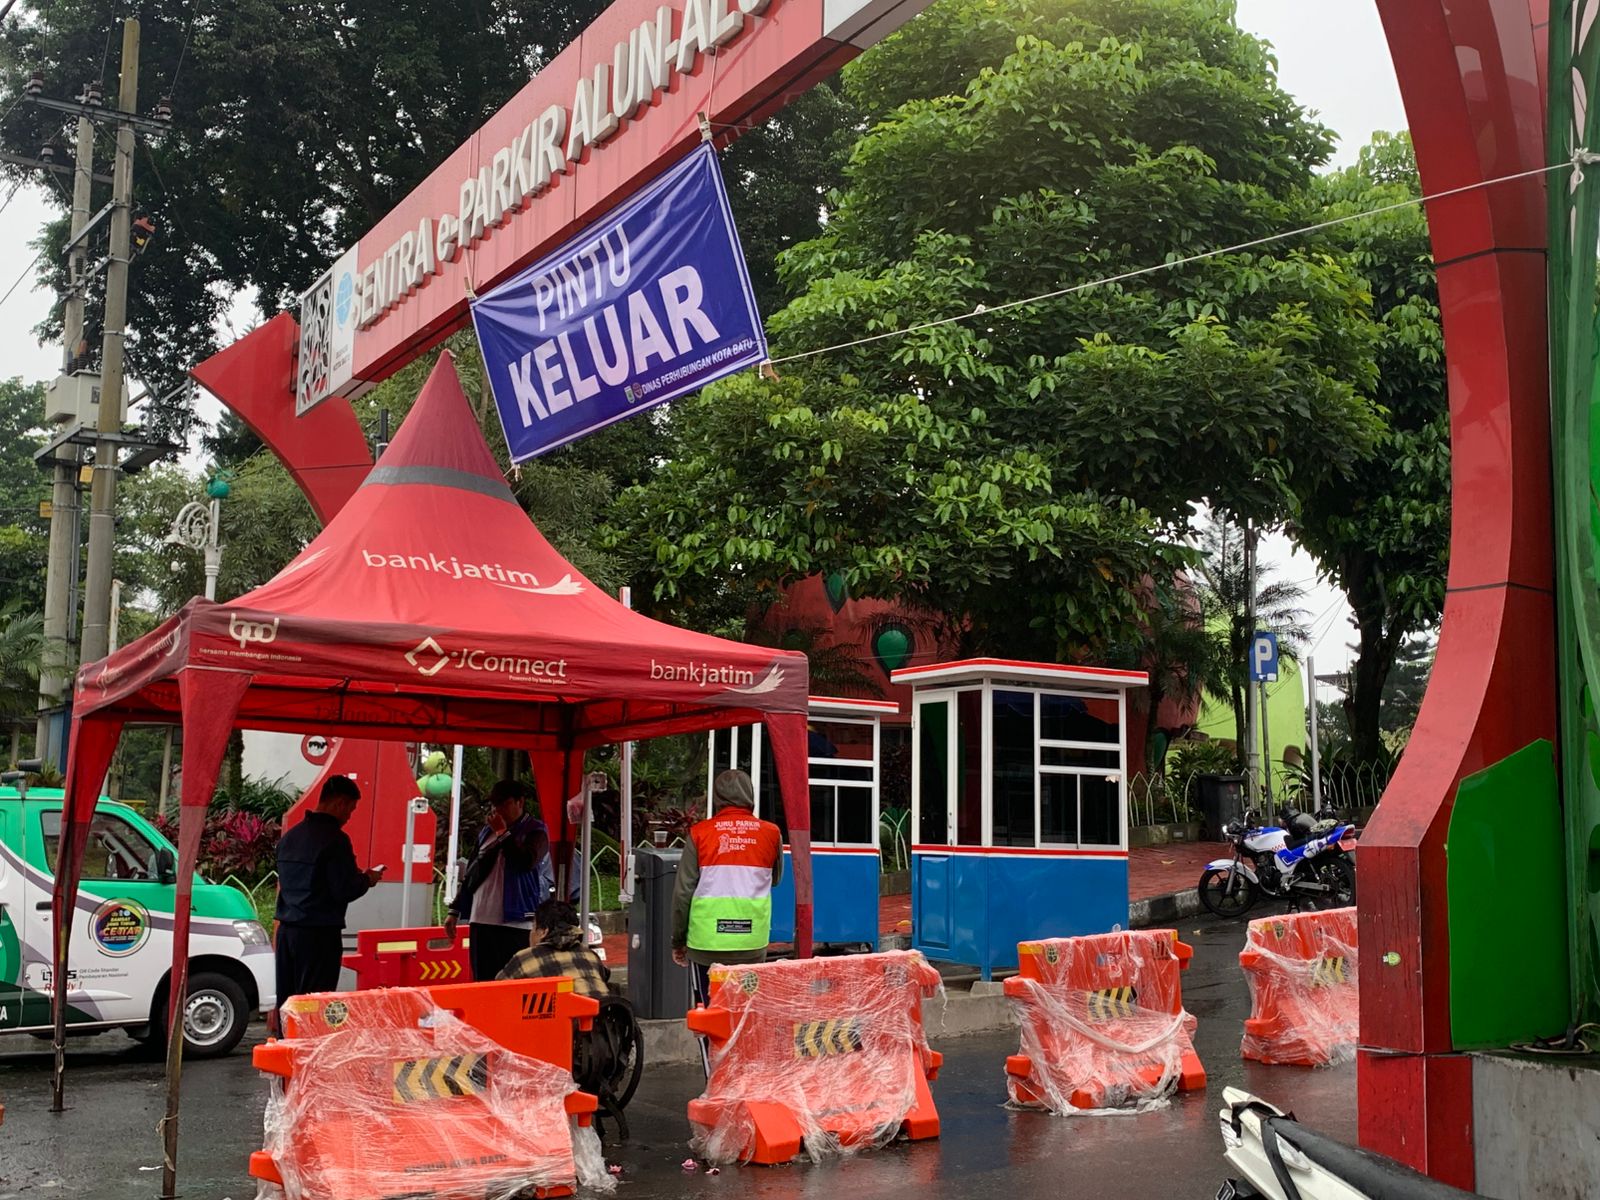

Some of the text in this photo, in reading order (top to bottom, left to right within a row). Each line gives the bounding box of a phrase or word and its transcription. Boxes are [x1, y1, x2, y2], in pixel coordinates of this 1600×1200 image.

[351, 217, 435, 331] SENTRA
[437, 104, 567, 262] e-PARKIR
[531, 223, 631, 332] PINTU
[508, 265, 721, 428] KELUAR
[641, 338, 753, 395] DINAS PERHUBUNGAN KOTA BATU
[362, 549, 540, 586] bankjatim
[455, 648, 567, 677] JConnect
[650, 659, 754, 687] bankjatim
[1254, 638, 1273, 674] P
[735, 820, 760, 828] PARKIR
